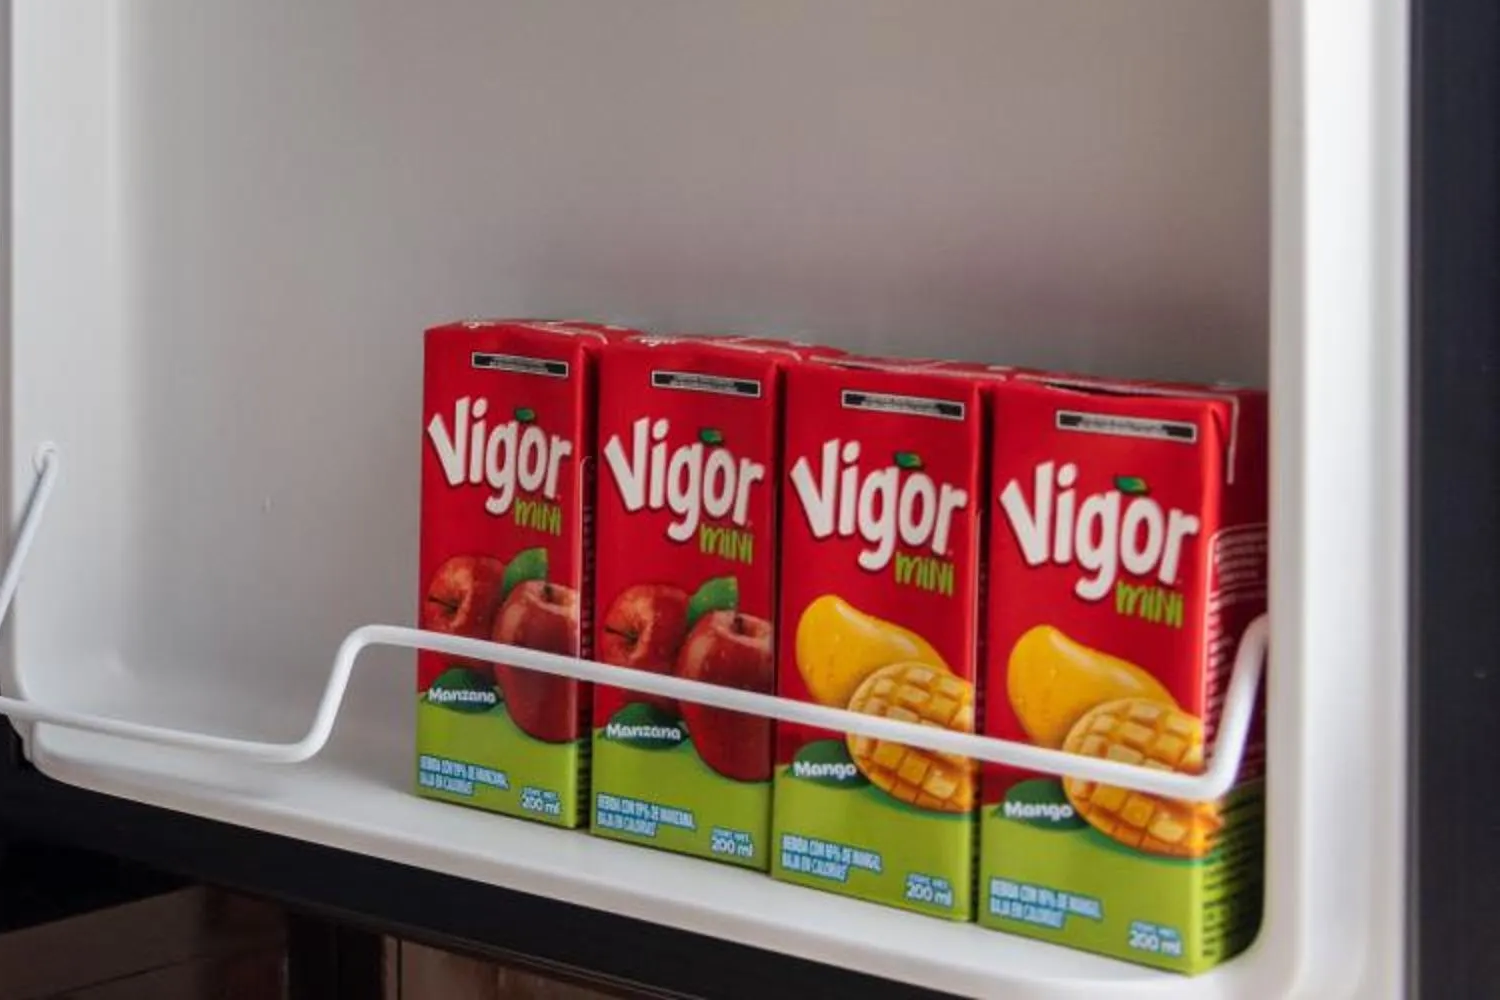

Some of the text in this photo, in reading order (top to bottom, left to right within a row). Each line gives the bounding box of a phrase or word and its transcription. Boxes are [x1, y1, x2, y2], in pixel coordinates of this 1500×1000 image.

[428, 396, 573, 515] Vigor
[603, 416, 765, 541] Vigor
[790, 438, 968, 571] Vigor
[999, 461, 1200, 600] Vigor
[428, 686, 496, 704] Manzana
[606, 723, 682, 741] Manzana
[793, 760, 857, 779] Mango
[1003, 800, 1074, 821] Mango
[906, 884, 953, 906] 200 ml
[1128, 931, 1159, 951] 200
